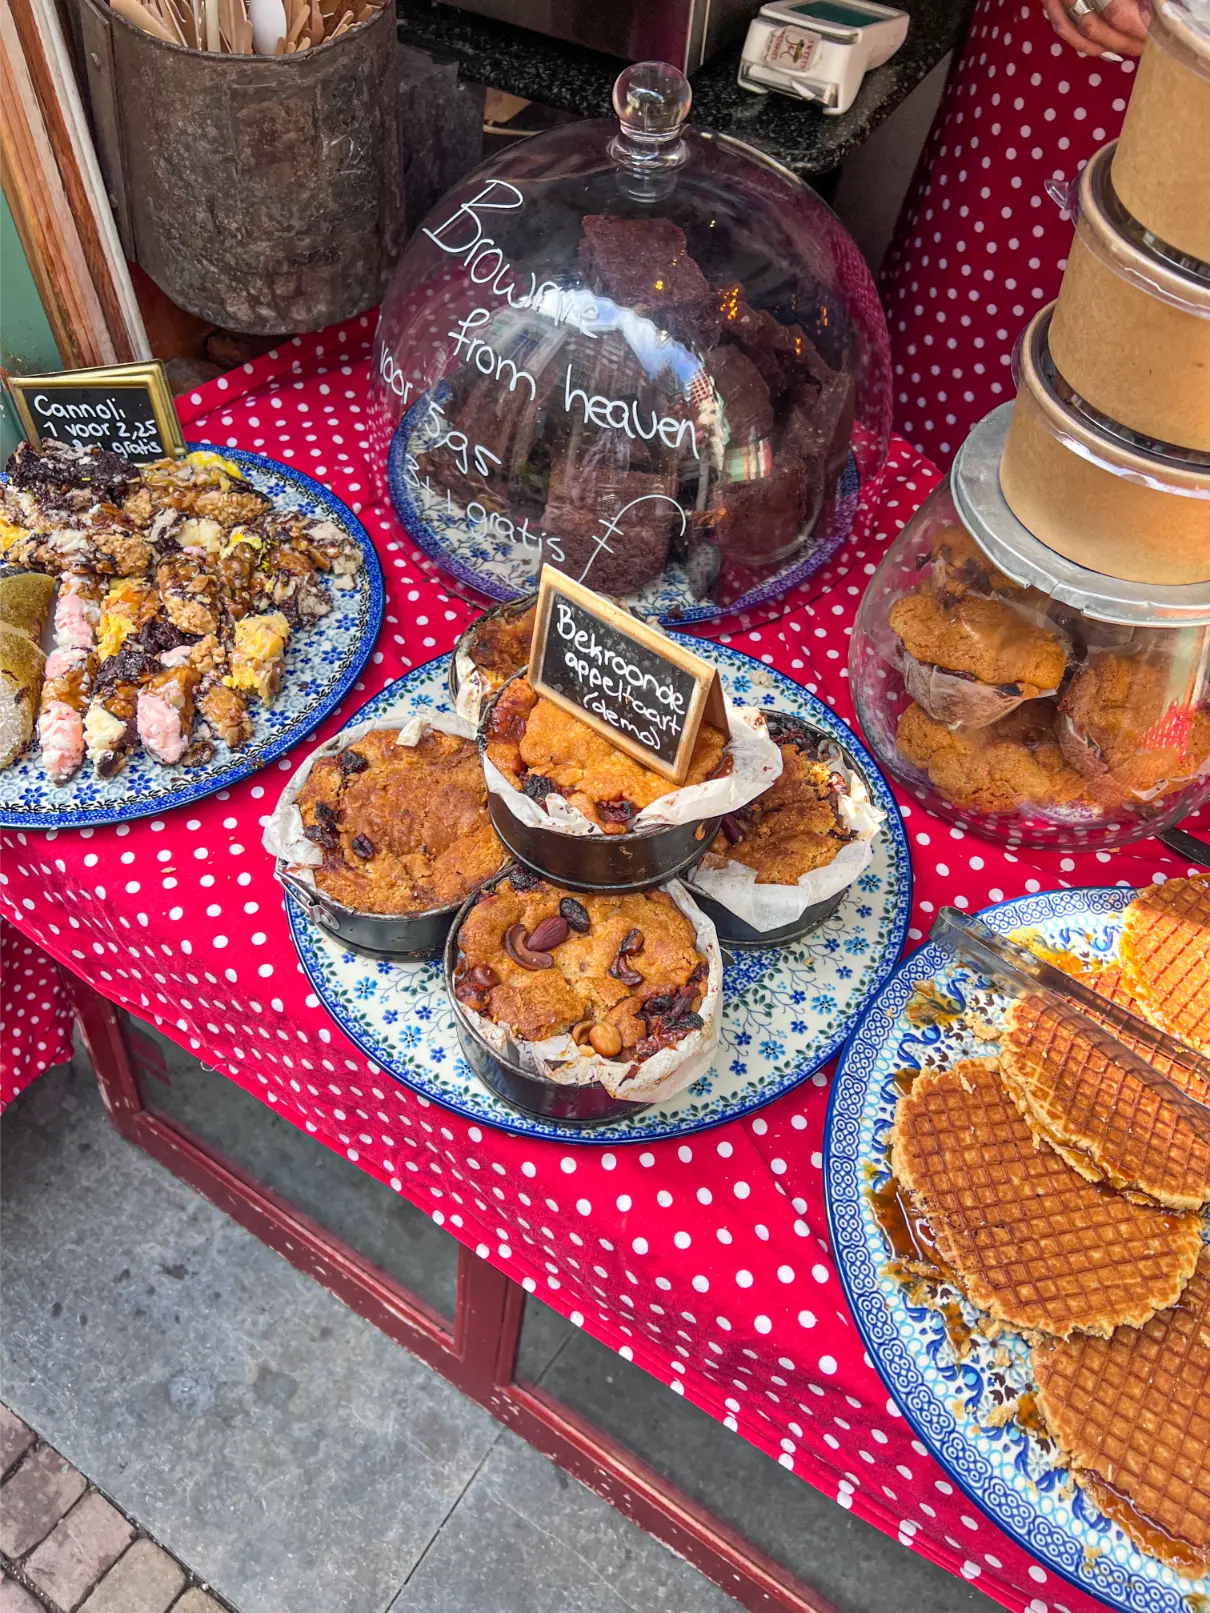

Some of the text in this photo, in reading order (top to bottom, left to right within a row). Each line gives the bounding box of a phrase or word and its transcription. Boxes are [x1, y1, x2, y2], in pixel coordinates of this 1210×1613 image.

[33, 394, 126, 420] Cannoli
[447, 308, 700, 460] from heaven
[43, 419, 158, 440] 1 voor 2,25
[112, 439, 163, 459] gratis
[466, 501, 566, 562] gratis
[556, 604, 686, 715] Bekroonde
[564, 651, 682, 736] appeltaart
[583, 691, 661, 751] (demo)
